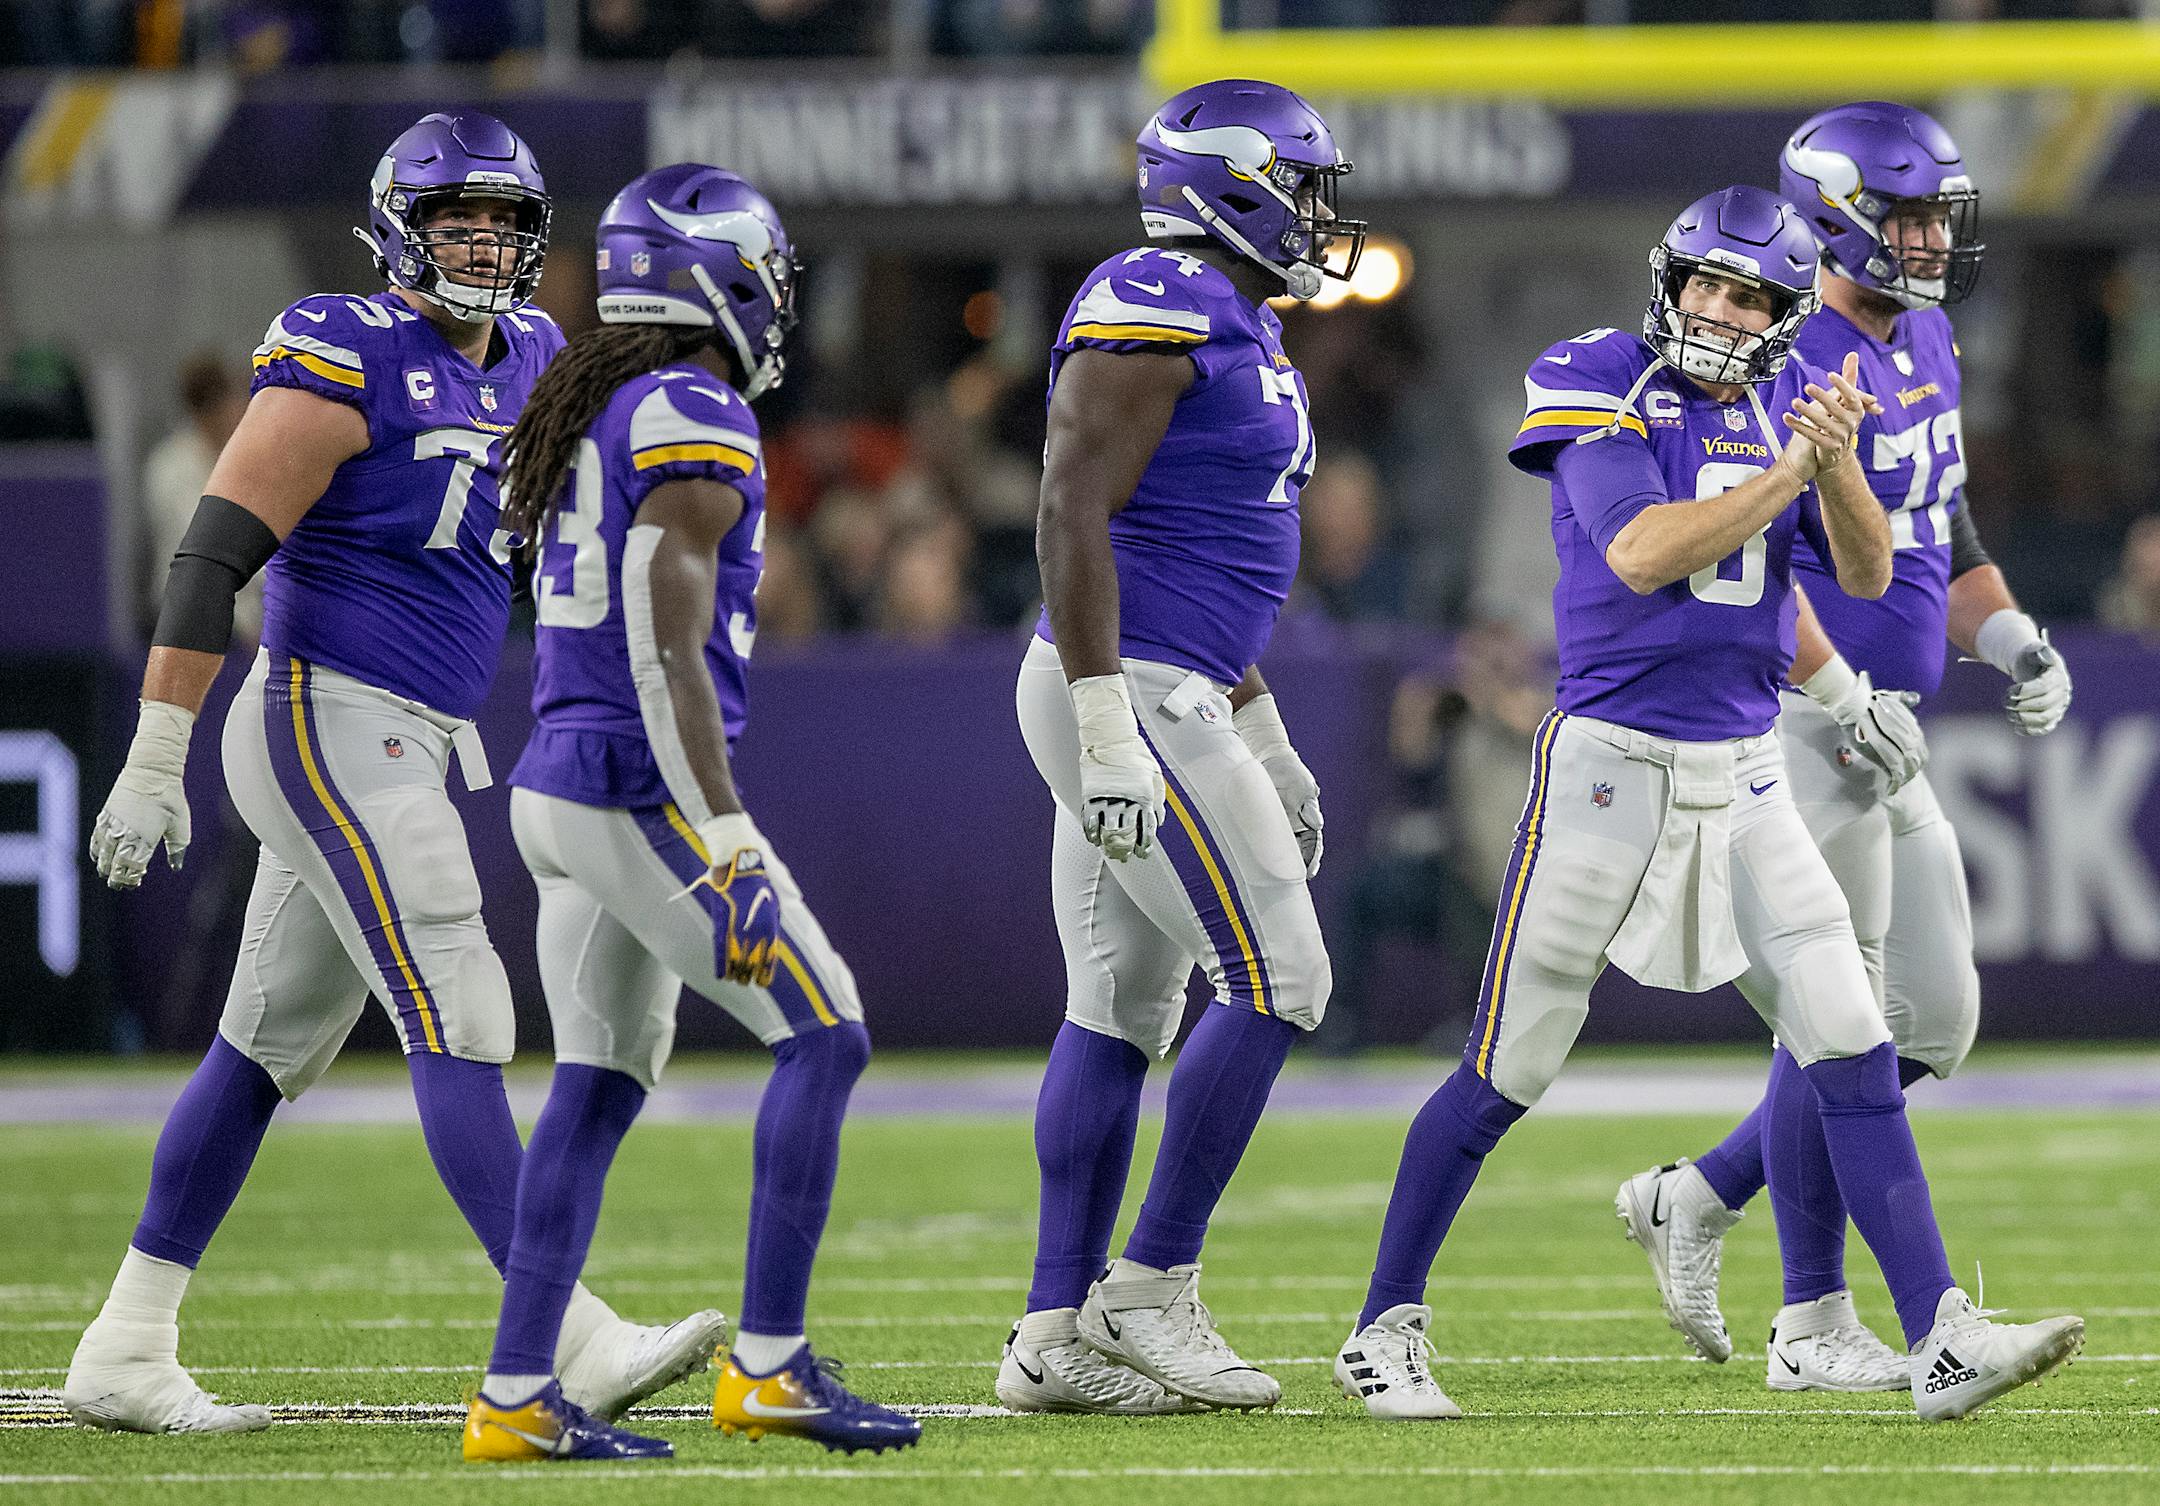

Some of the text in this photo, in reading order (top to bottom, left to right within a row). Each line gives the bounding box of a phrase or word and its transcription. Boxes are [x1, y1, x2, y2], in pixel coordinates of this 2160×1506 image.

[623, 304, 666, 315] CHANGE
[406, 370, 436, 401] C
[1645, 390, 1681, 418] C
[1873, 408, 1967, 550] 72
[1925, 1367, 1979, 1394] adidas
